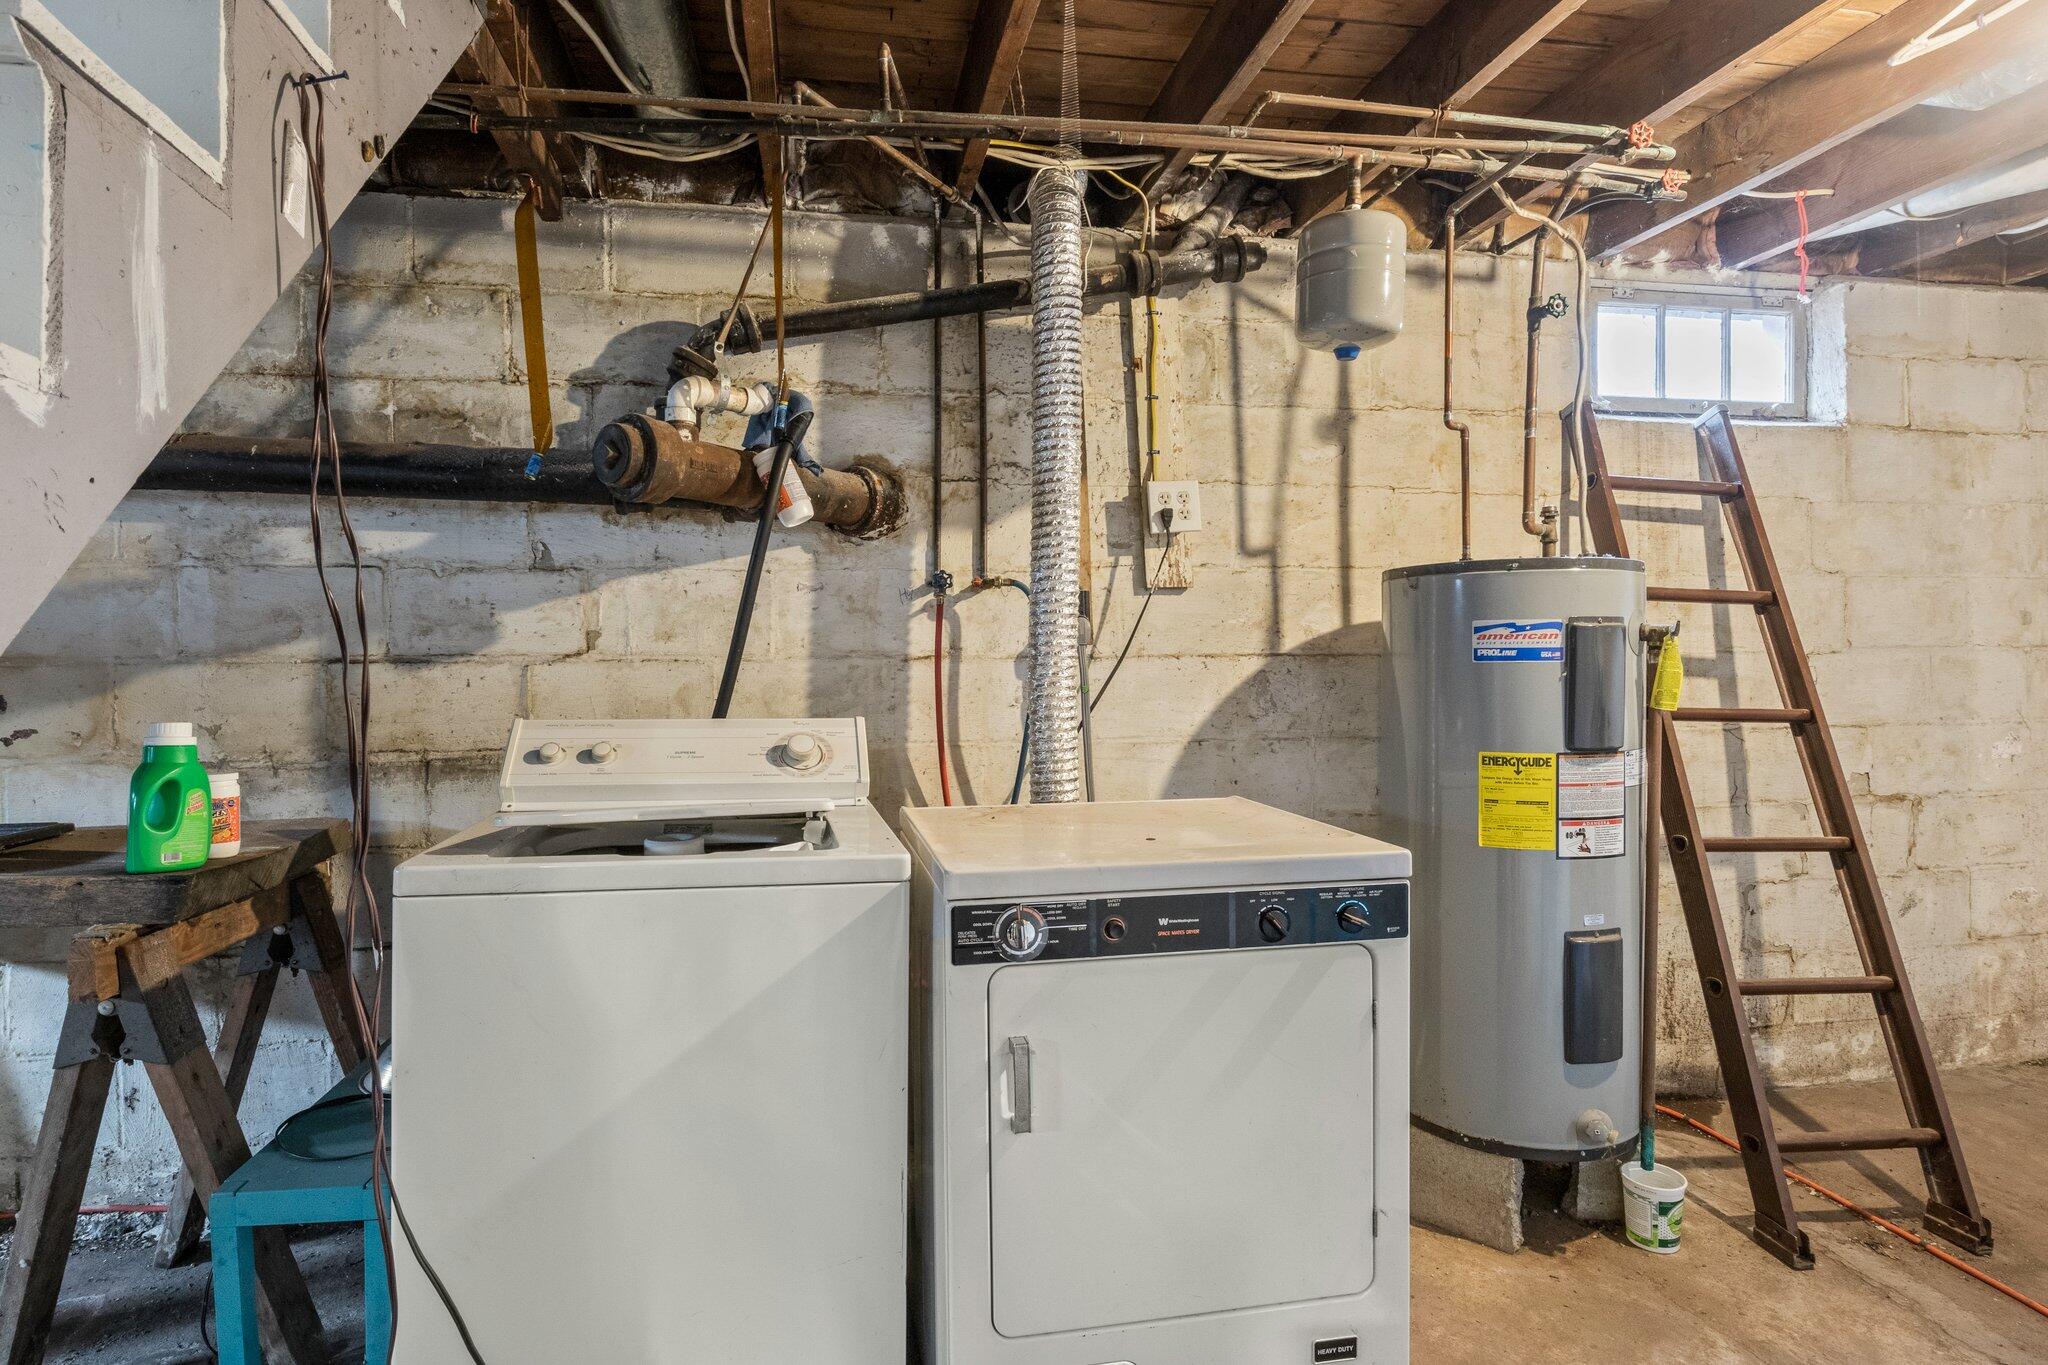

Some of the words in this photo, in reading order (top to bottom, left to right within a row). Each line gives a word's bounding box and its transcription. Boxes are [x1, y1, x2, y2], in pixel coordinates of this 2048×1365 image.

[1477, 632, 1559, 641] american
[1482, 755, 1552, 768] ENERGYGUIDE
[1317, 1347, 1337, 1355] HEAVY
[1337, 1345, 1354, 1353] DUTY
